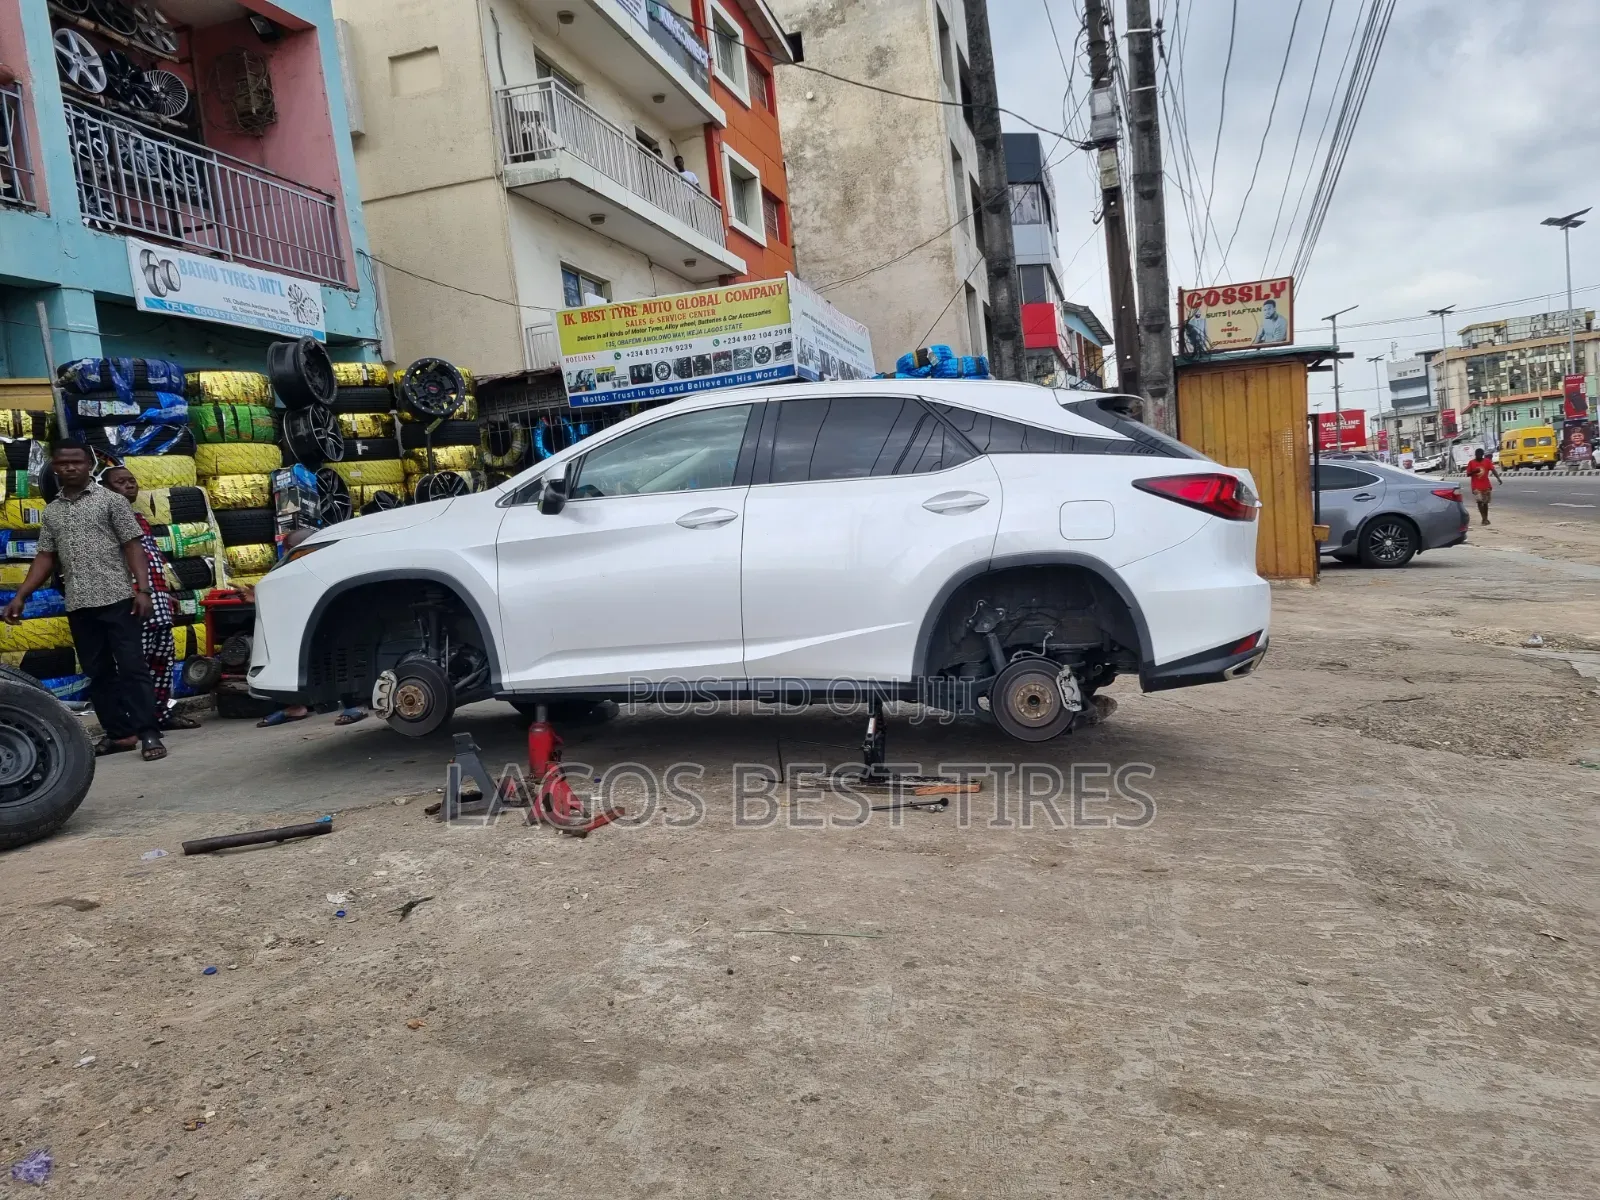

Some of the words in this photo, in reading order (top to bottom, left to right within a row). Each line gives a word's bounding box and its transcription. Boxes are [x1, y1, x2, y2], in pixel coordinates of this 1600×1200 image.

[178, 257, 218, 283] BATHO
[219, 267, 256, 291] TYRES
[257, 275, 286, 298] INT'L
[165, 302, 192, 313] TEL:
[580, 308, 606, 324] BEST
[609, 304, 638, 320] TYRE
[642, 300, 672, 316] AUTO
[676, 294, 722, 310] GLOBAL
[725, 283, 784, 303] COMPANY
[1232, 307, 1262, 316] KAFTAN
[626, 318, 646, 328] SALES
[649, 316, 654, 324] &
[656, 312, 686, 324] SERVICE
[689, 309, 716, 319] CENTER
[664, 324, 678, 332] Alloy
[698, 317, 722, 326] Batteries
[738, 309, 772, 320] Accessories
[617, 337, 641, 346] OBAFEMI
[642, 334, 672, 342] AWOLOWO
[686, 328, 702, 336] IKEJA
[704, 326, 723, 334] LAGOS
[724, 323, 743, 332] STATE
[723, 336, 740, 344] +234
[744, 334, 756, 342] 802
[759, 330, 772, 338] 104
[774, 328, 792, 336] 2918
[566, 354, 596, 364] HOTLINES
[626, 350, 643, 358] +234
[660, 346, 673, 354] 276
[676, 344, 692, 352] 9239
[582, 395, 610, 404] Motto:
[612, 390, 635, 400] Trust
[638, 388, 646, 396] in
[649, 386, 666, 394] God
[668, 383, 684, 393] and
[688, 378, 721, 390] Believe
[724, 376, 733, 384] in
[736, 374, 752, 383] His
[756, 369, 782, 380] Word.
